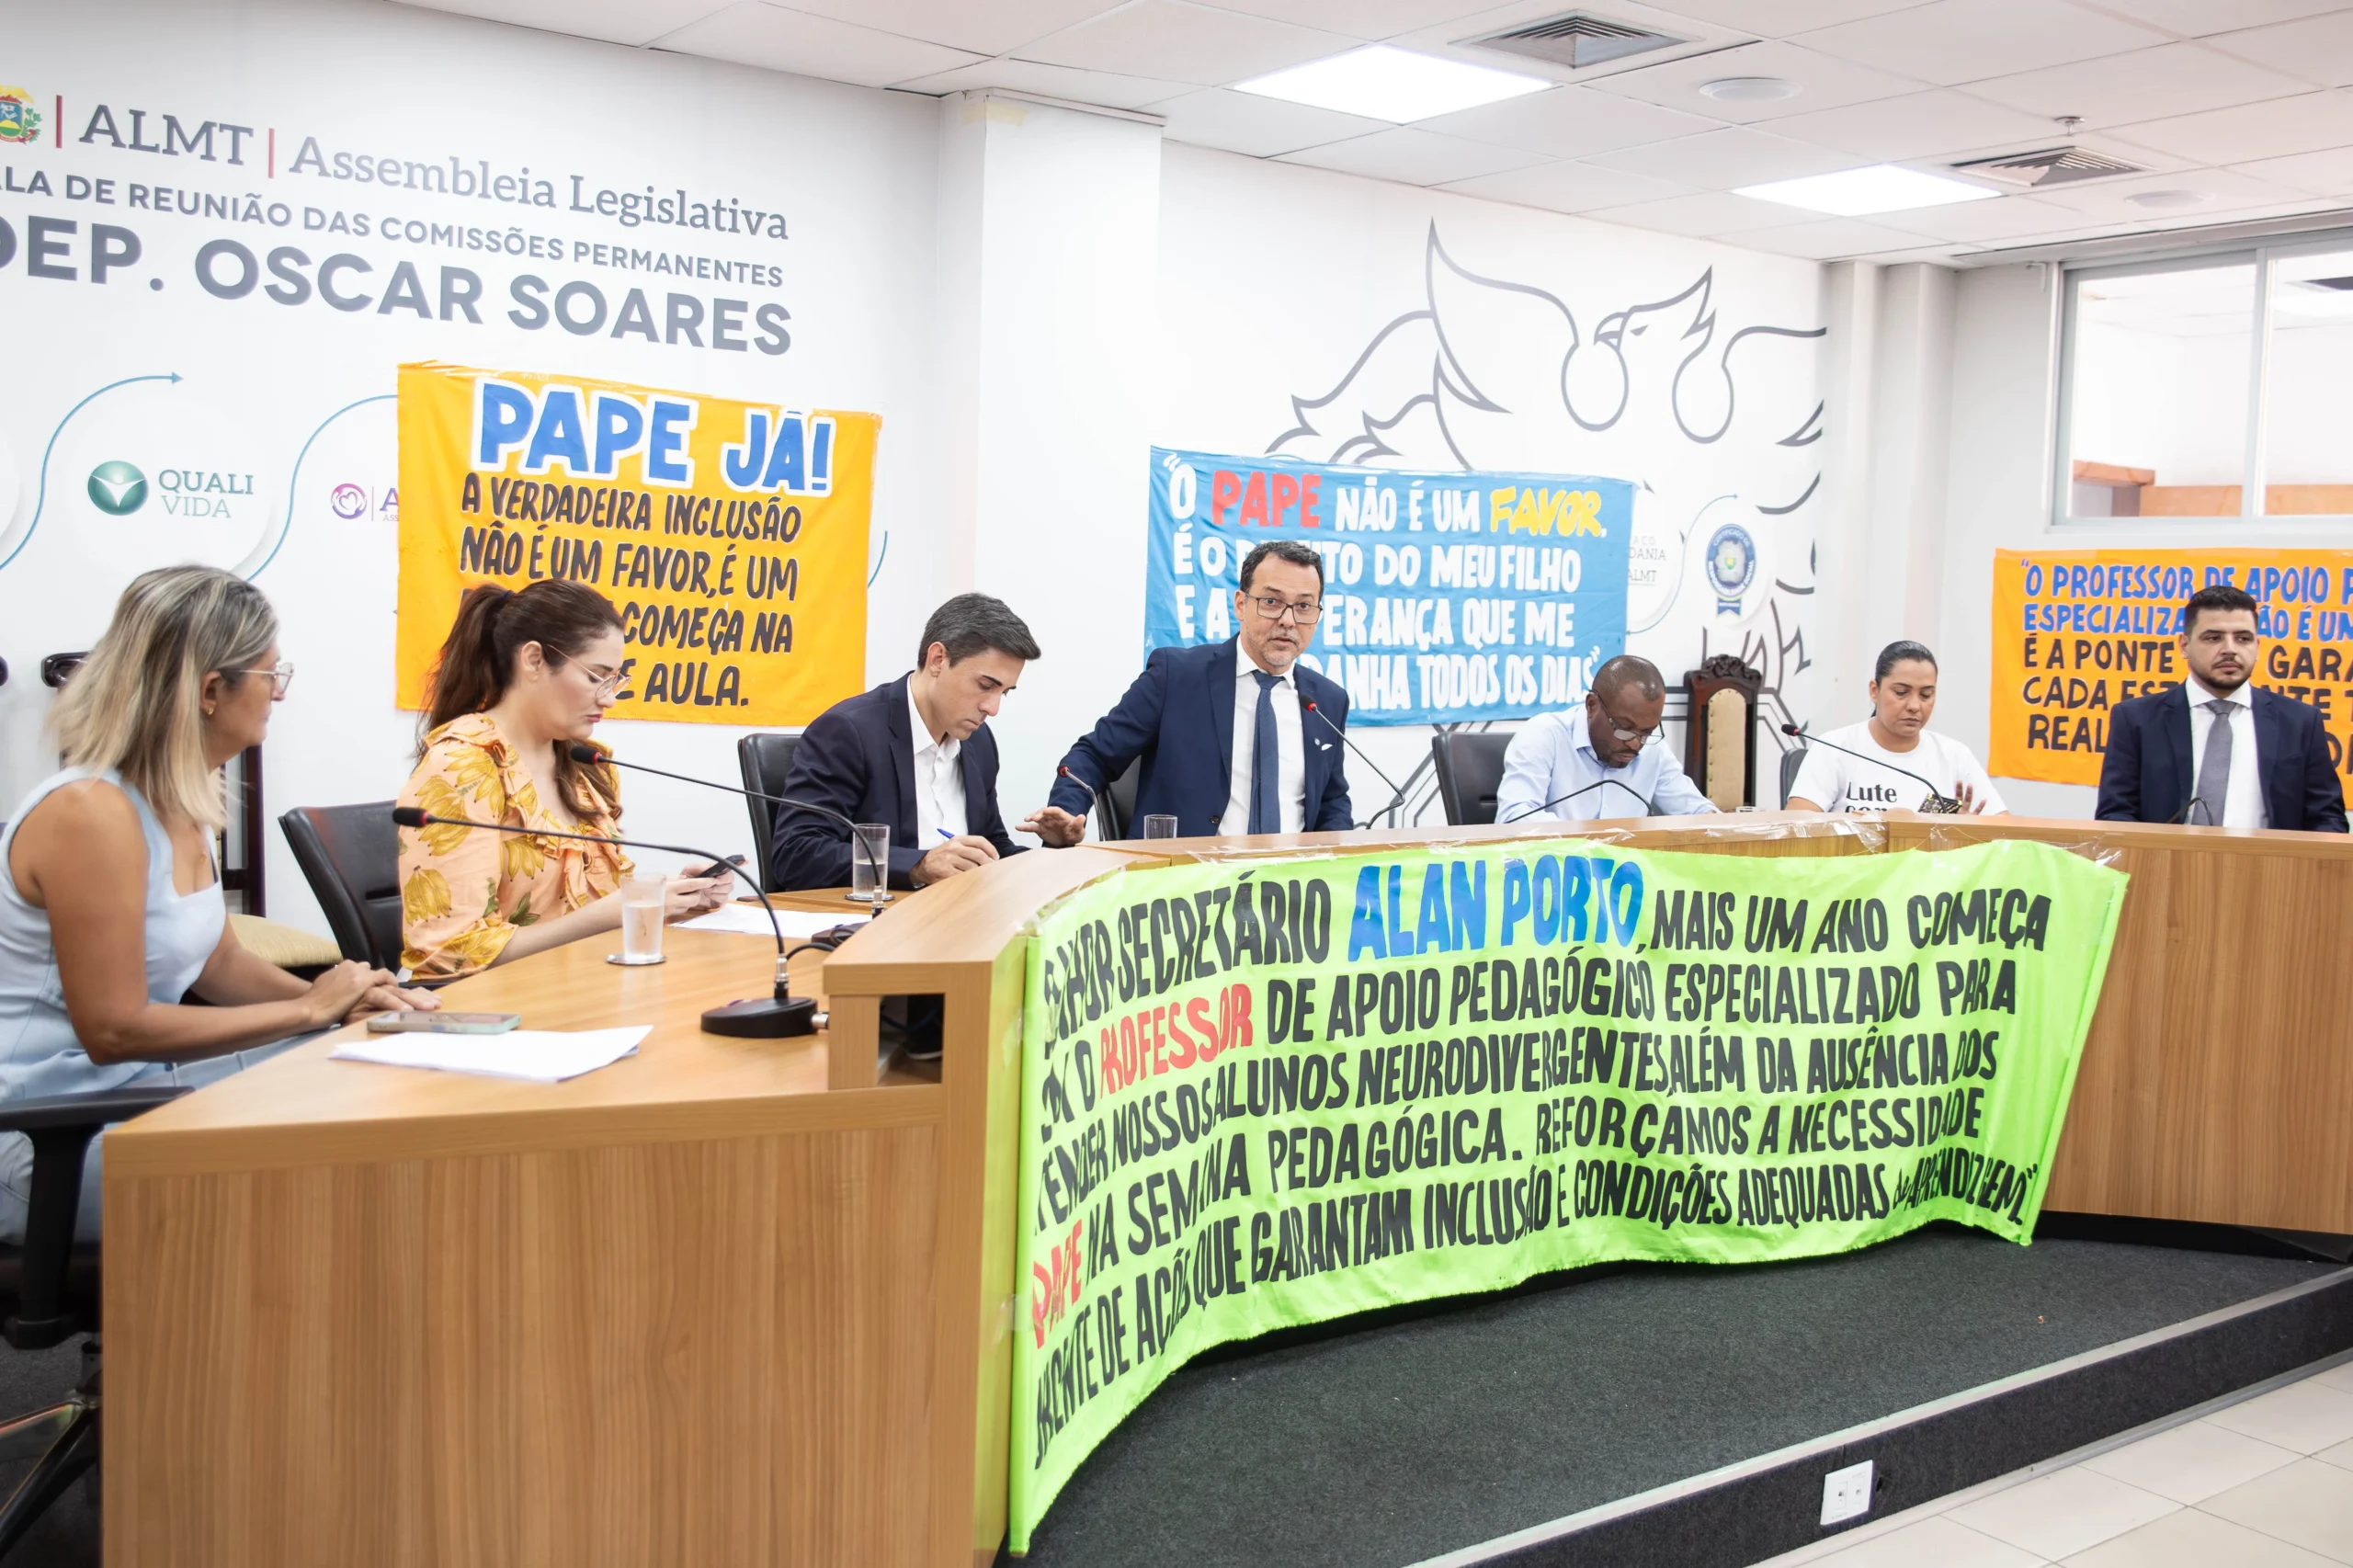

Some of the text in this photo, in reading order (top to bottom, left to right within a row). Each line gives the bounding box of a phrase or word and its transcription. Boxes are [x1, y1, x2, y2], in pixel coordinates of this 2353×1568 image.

[79, 104, 789, 241] ALMT Assembleia Legislativa
[0, 166, 783, 287] LA DE REUNIÃO DAS COMISSÕES PERMANENTES
[195, 238, 483, 324] OSCAR
[507, 274, 791, 356] SOARES
[475, 379, 696, 486] PAPE
[159, 469, 254, 495] QUALI
[161, 495, 232, 518] VIDA
[461, 472, 801, 543] A VERDADEIRA INCLUSÃO
[1211, 470, 1322, 528] PAPE
[1335, 476, 1397, 532] NÃO
[1409, 480, 1424, 531] É
[1432, 489, 1480, 532] UM
[460, 520, 523, 574] NÃO
[529, 524, 549, 578] É
[550, 537, 602, 584] UM
[719, 543, 736, 595] É
[745, 555, 799, 601] UM
[1173, 523, 1193, 574] É
[1199, 537, 1226, 576] O
[1374, 543, 1421, 586] DO
[1430, 545, 1495, 588] MEU
[1500, 545, 1581, 593] FILHO
[2052, 564, 2194, 599] PROFESSOR
[2245, 566, 2329, 603] APOIO
[623, 600, 792, 653] COMEÇA NA
[1176, 585, 1574, 651] E A ERANÇA QUE ME
[2023, 603, 2186, 636] ESPECIALIZA
[2257, 604, 2289, 639] ÃO
[2297, 605, 2312, 641] É
[644, 662, 749, 706] AULA.
[1416, 653, 1498, 709] TODOS
[1505, 653, 1538, 705] OS
[2024, 633, 2038, 668] É
[2046, 638, 2064, 668] A
[2075, 639, 2175, 673] PONTE
[2022, 676, 2109, 711] CADA
[1846, 781, 1897, 802] Lute
[1118, 870, 1331, 1004] SECRETÁRIO
[1347, 859, 1486, 962] ALAN
[1650, 889, 1735, 951] MAIS
[1745, 895, 1808, 953] UM
[1811, 897, 1888, 954] ANO
[1906, 887, 2052, 952] COMEÇA
[1075, 1040, 1096, 1112] O
[1100, 983, 1253, 1099] PROFESSOR
[1267, 978, 1315, 1045] DE
[1326, 968, 1441, 1042] APOIO
[1665, 961, 1920, 1025] ESPECIALIZADO
[1937, 958, 2017, 1017] PARA
[1112, 1077, 1211, 1173] NOSSOS
[1212, 1052, 1348, 1129] ALUNOS
[1670, 1025, 1746, 1093] ALÉM
[1756, 1036, 1798, 1094] DA
[1806, 1025, 1946, 1094] AUSÊNCIA
[1952, 1028, 1999, 1082] DOS
[1086, 1192, 1120, 1287] NA
[1268, 1105, 1522, 1194] PEDAGÓGICA.
[1536, 1095, 1751, 1158] REFORÇAMOS
[1757, 1106, 1781, 1155] A
[1788, 1087, 1984, 1155] NECESSIDADE
[1097, 1285, 1130, 1387] DE
[1193, 1215, 1246, 1312] QUE
[1251, 1188, 1414, 1285] GARANTAM
[1557, 1164, 1570, 1228] E
[1574, 1159, 1733, 1230] CONDIÇÕES
[1737, 1163, 1890, 1229] ADEQUADAS
